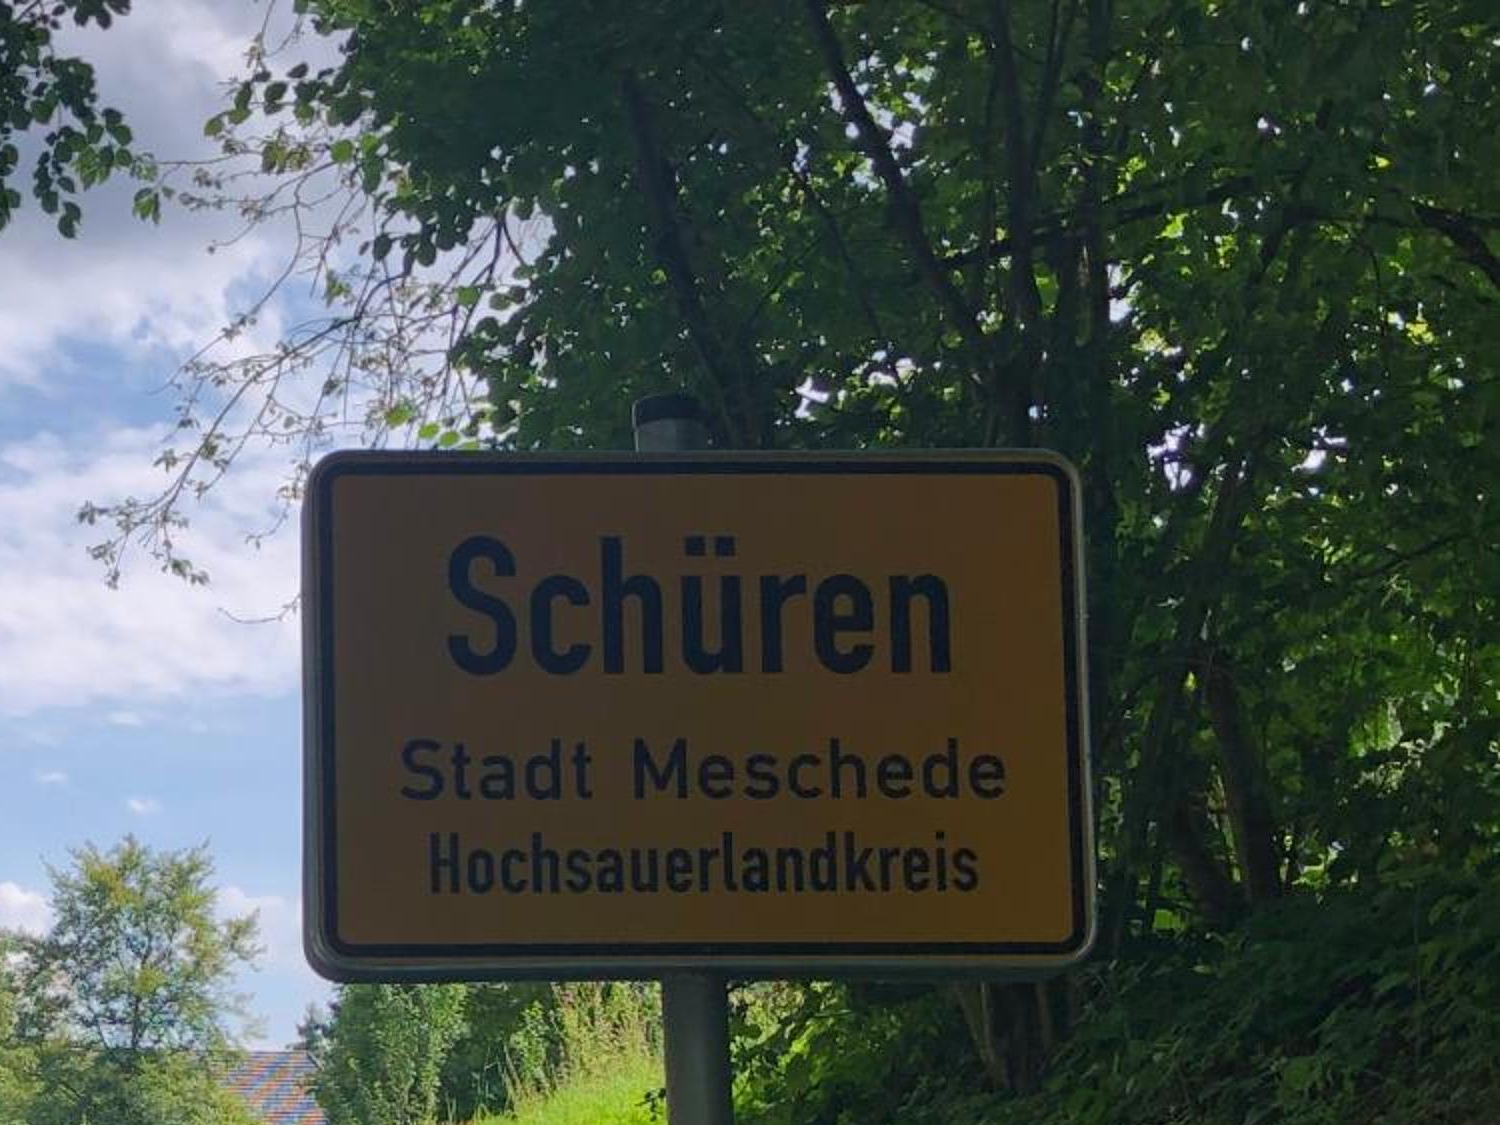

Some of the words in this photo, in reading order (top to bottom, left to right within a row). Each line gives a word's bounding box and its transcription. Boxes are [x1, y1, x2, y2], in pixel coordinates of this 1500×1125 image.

[447, 535, 952, 675] Schüren
[400, 738, 593, 801] Stadt
[633, 737, 1007, 801] Meschede
[429, 831, 979, 896] Hochsauerlandkreis
